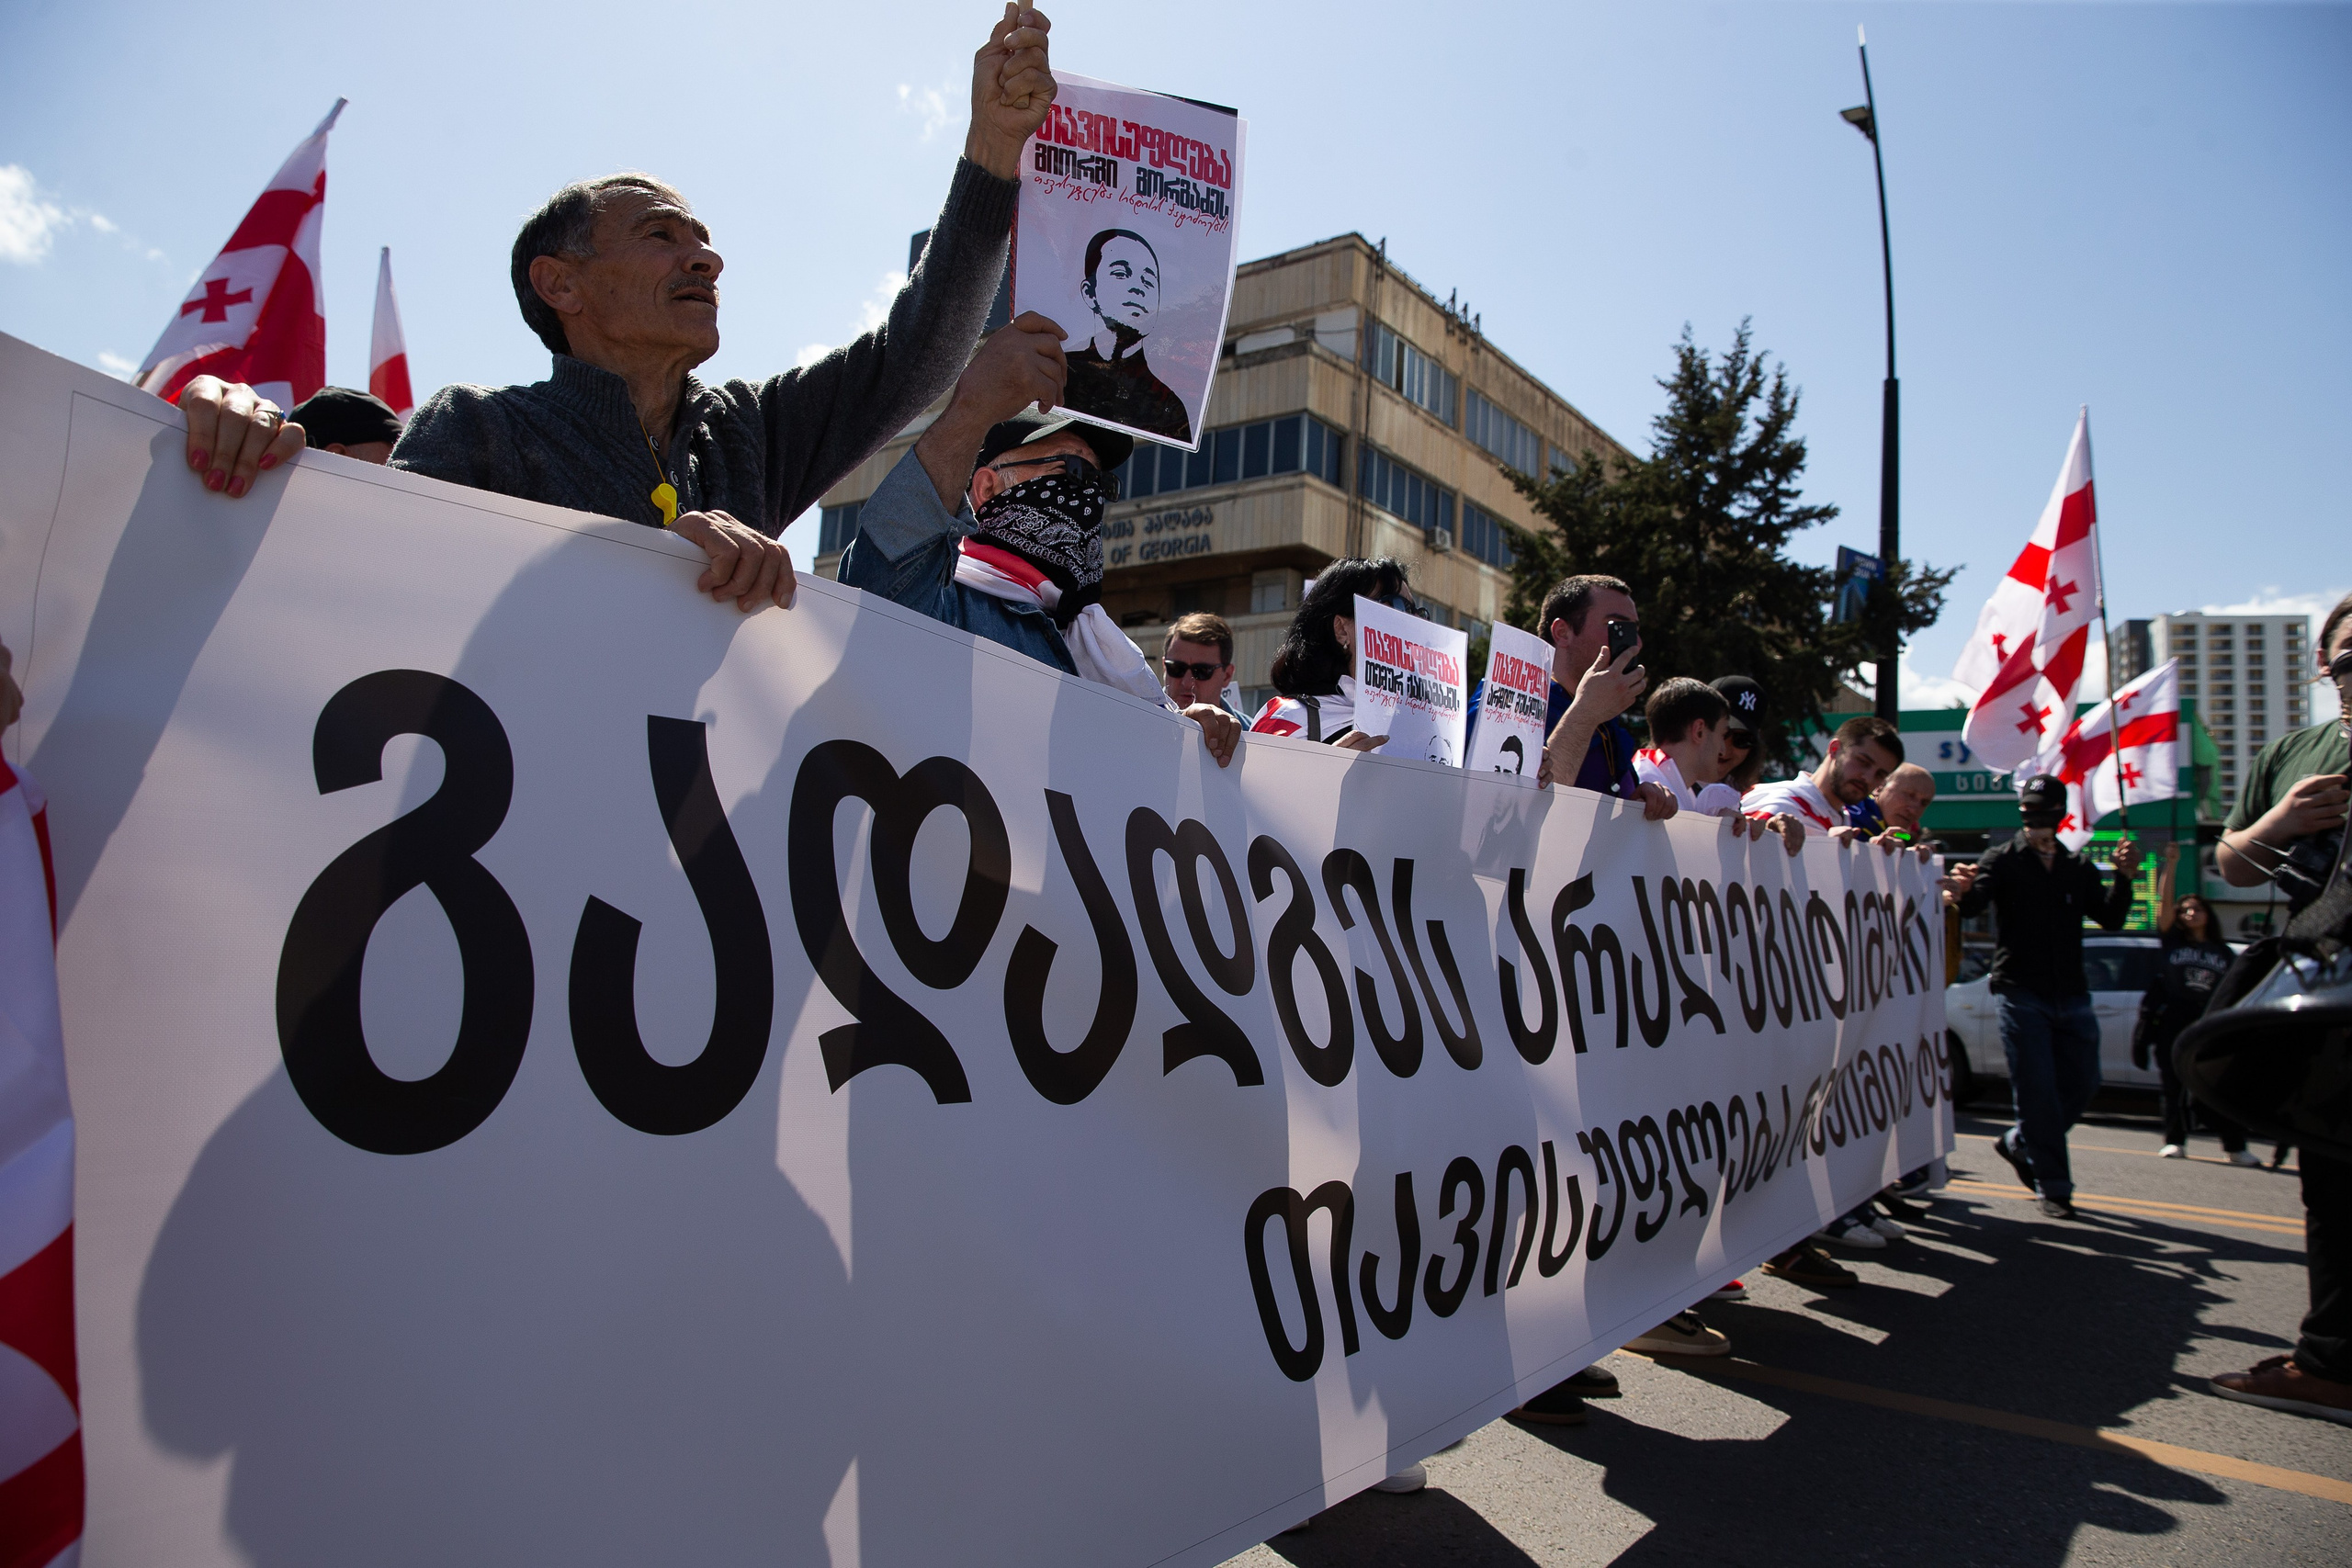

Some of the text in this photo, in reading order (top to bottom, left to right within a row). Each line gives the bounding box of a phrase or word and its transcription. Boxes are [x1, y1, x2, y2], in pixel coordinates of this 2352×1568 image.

[1035, 103, 1231, 189] თავისუფლება
[1035, 142, 1118, 188] გიორგი
[1110, 533, 1212, 565] OF GEORGIA
[1363, 626, 1460, 687] თავისუფლება
[1364, 660, 1404, 696] თემურ
[1738, 691, 1757, 711] NY
[277, 669, 1483, 1156] გადადგეს
[1244, 1085, 1790, 1382] თავისუფლება
